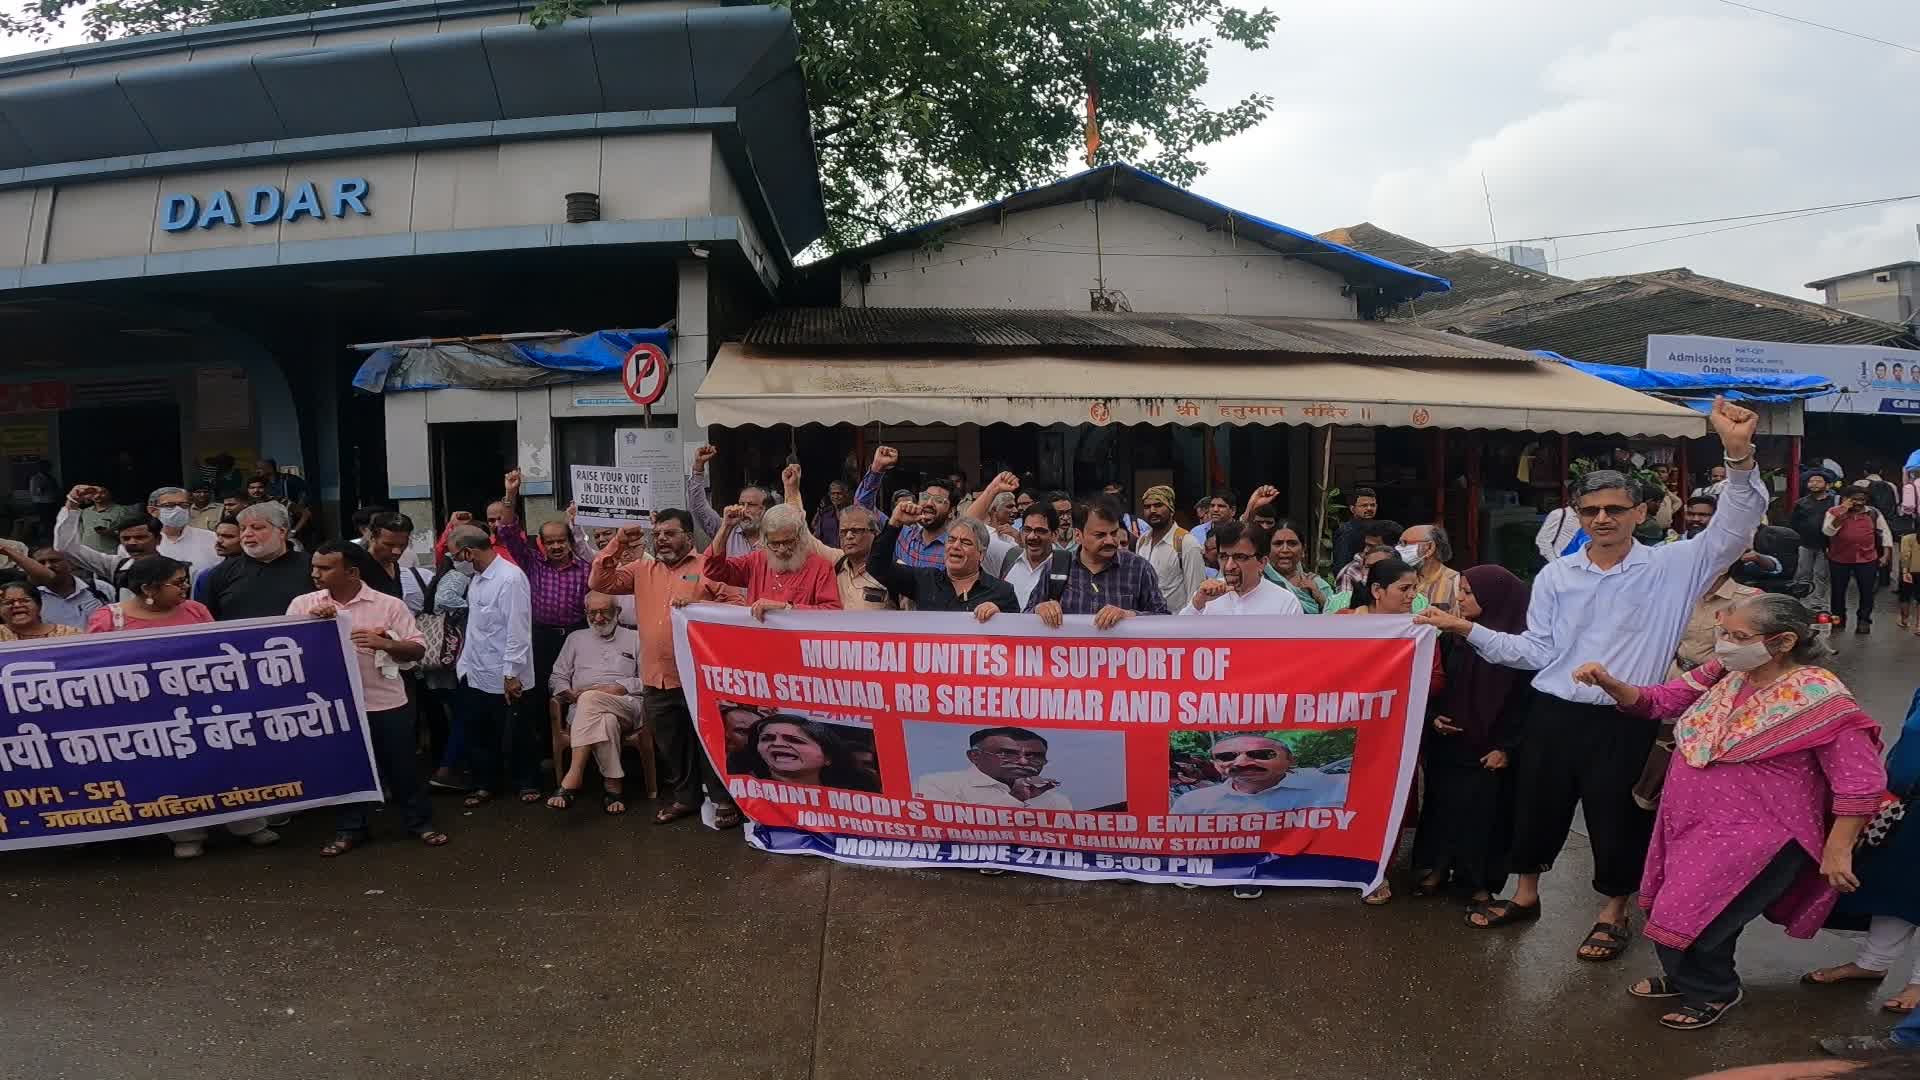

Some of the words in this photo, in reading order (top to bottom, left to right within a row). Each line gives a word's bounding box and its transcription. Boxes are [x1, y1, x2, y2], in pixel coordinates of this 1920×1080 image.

[161, 177, 371, 233] DADAR
[1668, 352, 1732, 365] Admissions
[1175, 402, 1200, 417] श्री
[1218, 405, 1286, 420] हनुमान
[1303, 404, 1349, 419] मंदिर
[576, 470, 598, 481] RAISE
[600, 471, 623, 483] YOUR
[624, 473, 649, 484] VOICE
[584, 483, 592, 492] IN
[594, 483, 629, 495] DEFENCE
[630, 486, 641, 496] OF
[580, 494, 615, 506] SECULAR
[0, 661, 150, 714] खिलाफ
[153, 643, 249, 697] बदले
[250, 637, 306, 688] की
[800, 639, 906, 673] MUMBAI
[913, 642, 1008, 677] UNITES
[1015, 645, 1043, 678] IN
[1051, 646, 1186, 680] SUPPORT
[1193, 648, 1231, 681] OF
[701, 664, 771, 699] TEESTA
[774, 676, 890, 713] SETALVAD,
[895, 683, 930, 713] RB
[936, 684, 1105, 722] SREEKUMAR
[1109, 689, 1171, 724] AND
[1179, 692, 1288, 725] SANJIV
[1295, 689, 1398, 723] BHATT
[52, 706, 198, 764] कारवाई
[197, 704, 256, 751] बंद
[39, 798, 134, 830] जनवादी
[137, 794, 216, 821] महिला
[218, 780, 304, 809] संघटना
[83, 780, 127, 801] SFI
[728, 778, 822, 808] AGAINT
[828, 787, 928, 823] MODI'S
[933, 806, 1138, 833] UNDECLARED
[1146, 808, 1358, 834] EMERGENCY
[797, 810, 837, 828] JOIN
[840, 815, 917, 838] PROTEST
[921, 825, 943, 839] AT
[947, 827, 1010, 843] DADAR
[1015, 829, 1068, 845] EAST
[1072, 834, 1166, 850] RAILWAY
[1169, 836, 1261, 851] STATION
[835, 837, 942, 862] MONDAY,
[947, 842, 1011, 863] JUNE
[1016, 846, 1090, 868] 27TH,
[1095, 853, 1161, 871] 5:00
[1168, 856, 1213, 875] PM
